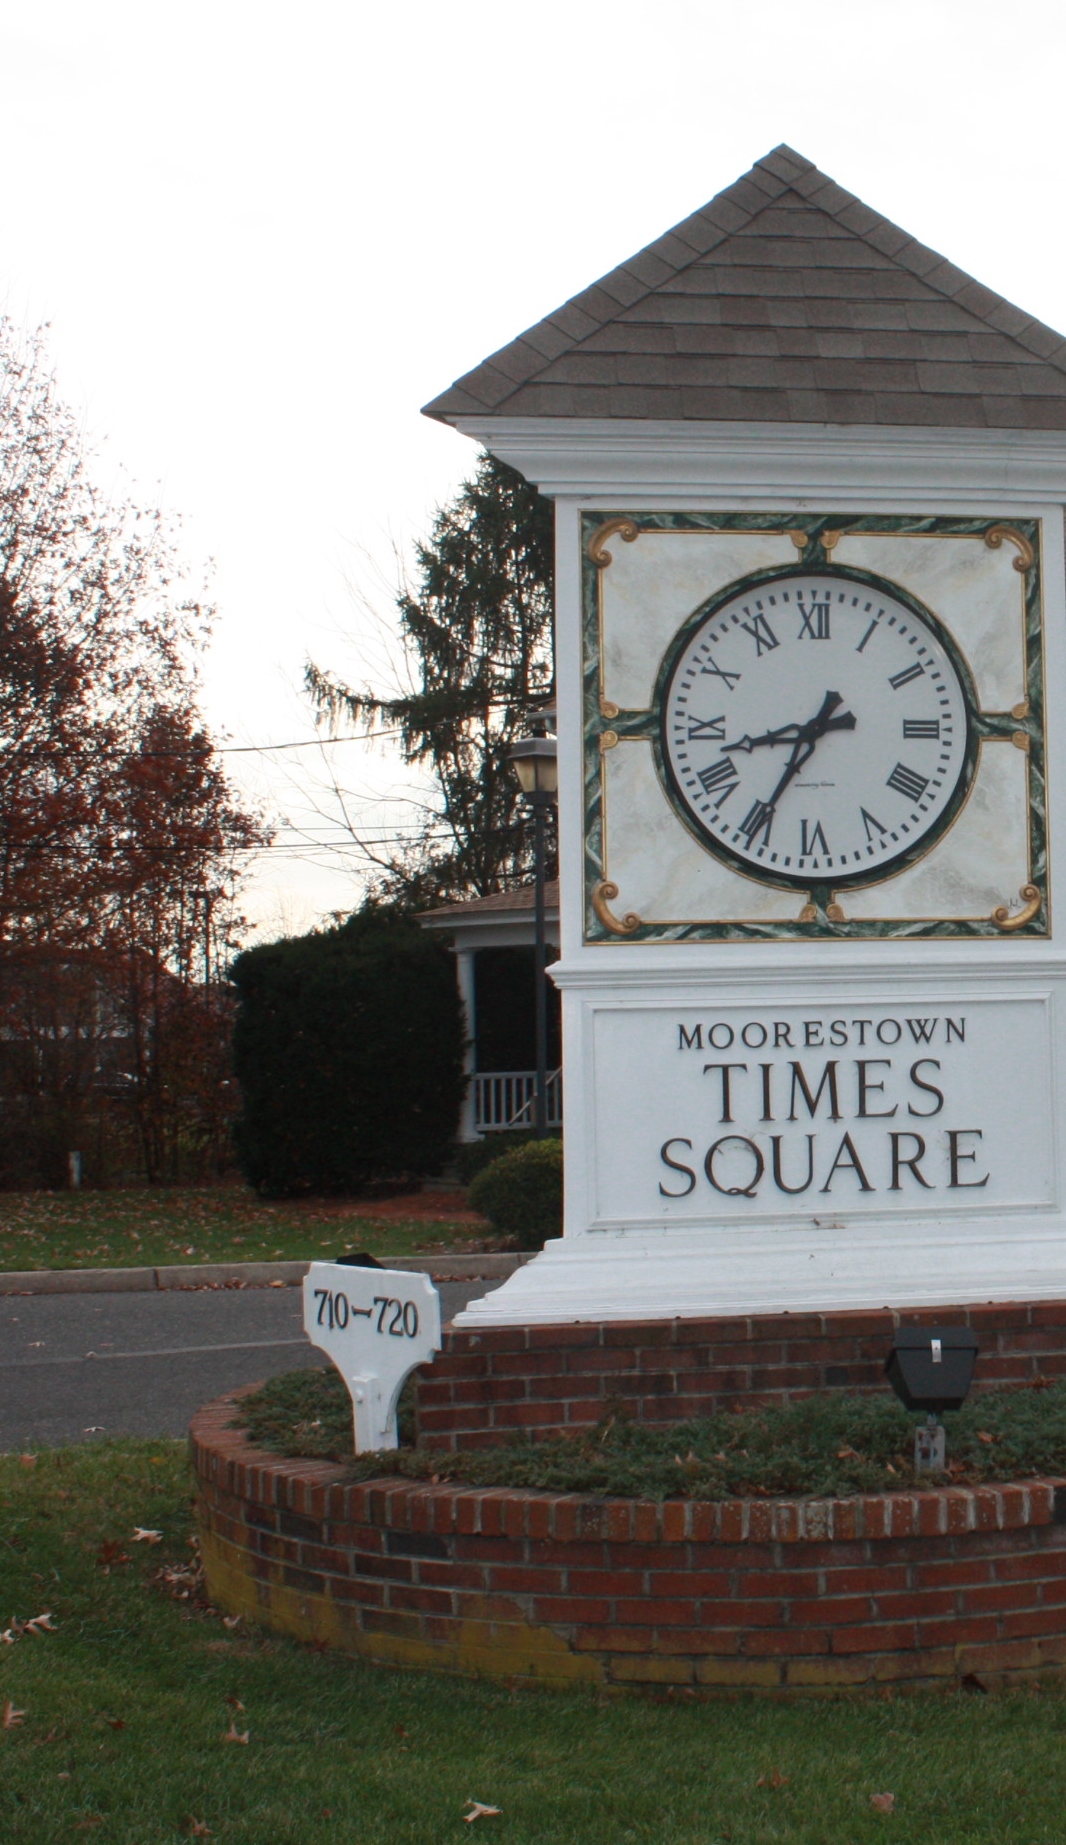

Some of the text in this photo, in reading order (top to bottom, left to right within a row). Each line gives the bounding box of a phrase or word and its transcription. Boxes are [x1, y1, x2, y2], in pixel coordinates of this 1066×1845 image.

[740, 612, 781, 657] XI
[797, 602, 831, 640] XII
[855, 619, 880, 653] I
[700, 656, 742, 691] X
[888, 660, 927, 690] II
[687, 714, 726, 741] IX
[902, 718, 941, 740] III
[695, 756, 740, 810] VIII
[885, 761, 930, 803] IIII
[800, 818, 830, 856] VI
[858, 805, 888, 842] V
[677, 1017, 966, 1051] MOORESTOWN
[703, 1058, 945, 1123] TIMES
[658, 1129, 991, 1199] SQUARE
[314, 1288, 419, 1339] 710-720
